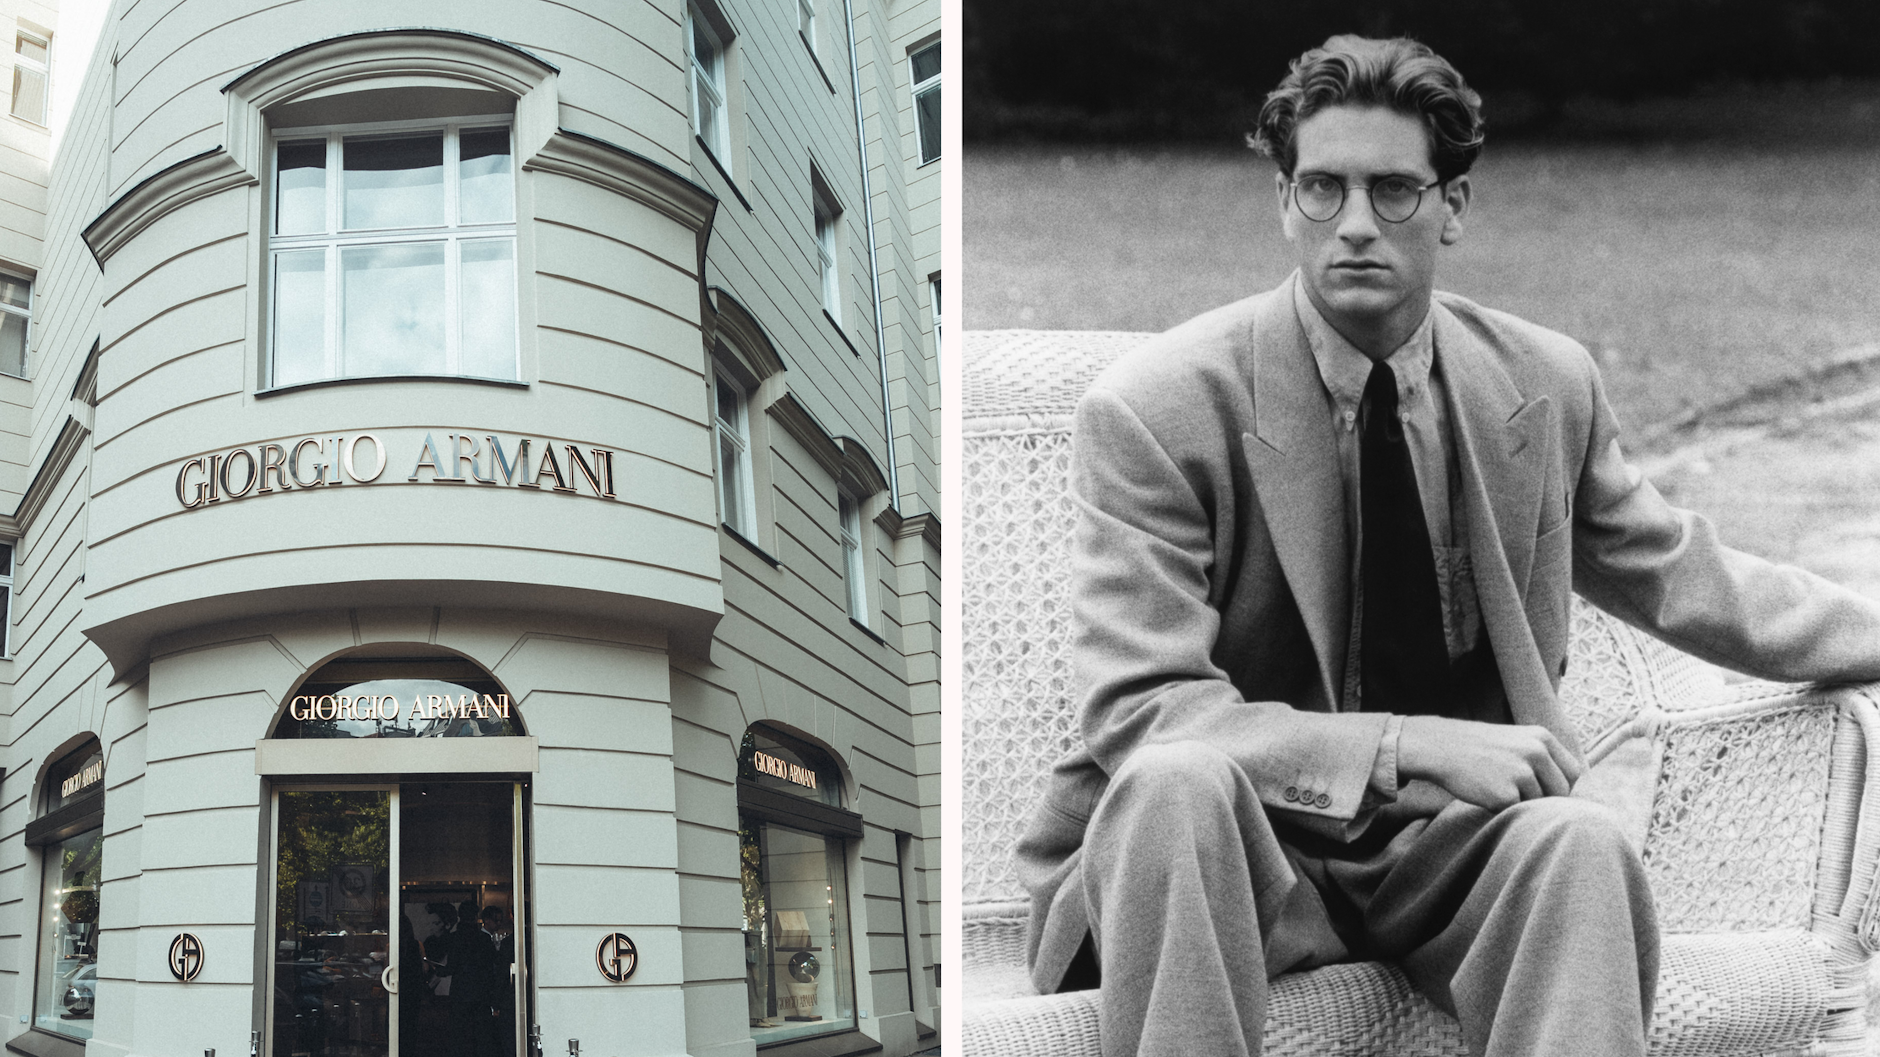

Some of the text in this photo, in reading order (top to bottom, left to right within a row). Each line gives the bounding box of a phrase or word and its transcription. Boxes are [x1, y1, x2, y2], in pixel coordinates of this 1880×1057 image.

[175, 431, 618, 508] GIORGIO ARMANI
[290, 693, 511, 721] GIORGIO ARMANI
[754, 750, 817, 790] GIORGIO ARMANI
[776, 993, 818, 1011] GIORGIO ARMANI
